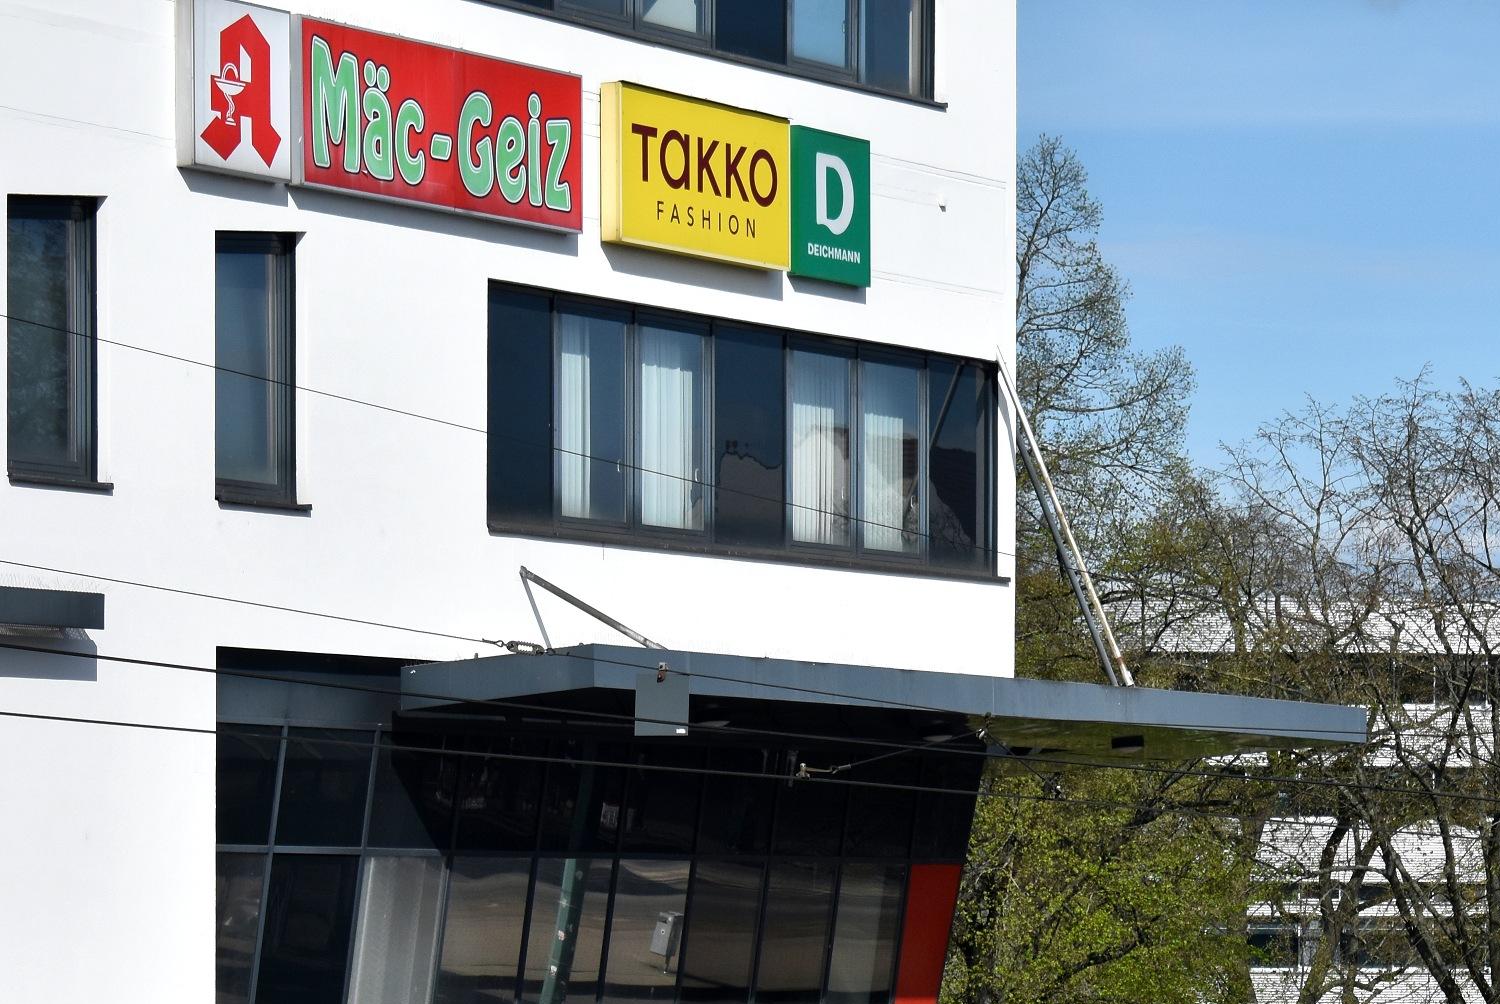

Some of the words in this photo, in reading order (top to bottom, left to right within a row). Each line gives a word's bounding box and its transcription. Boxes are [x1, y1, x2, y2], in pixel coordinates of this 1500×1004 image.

[311, 34, 572, 213] Mäc-Geiz
[656, 200, 756, 239] FASHION
[816, 151, 855, 236] D
[807, 242, 861, 264] DEICHMANN
